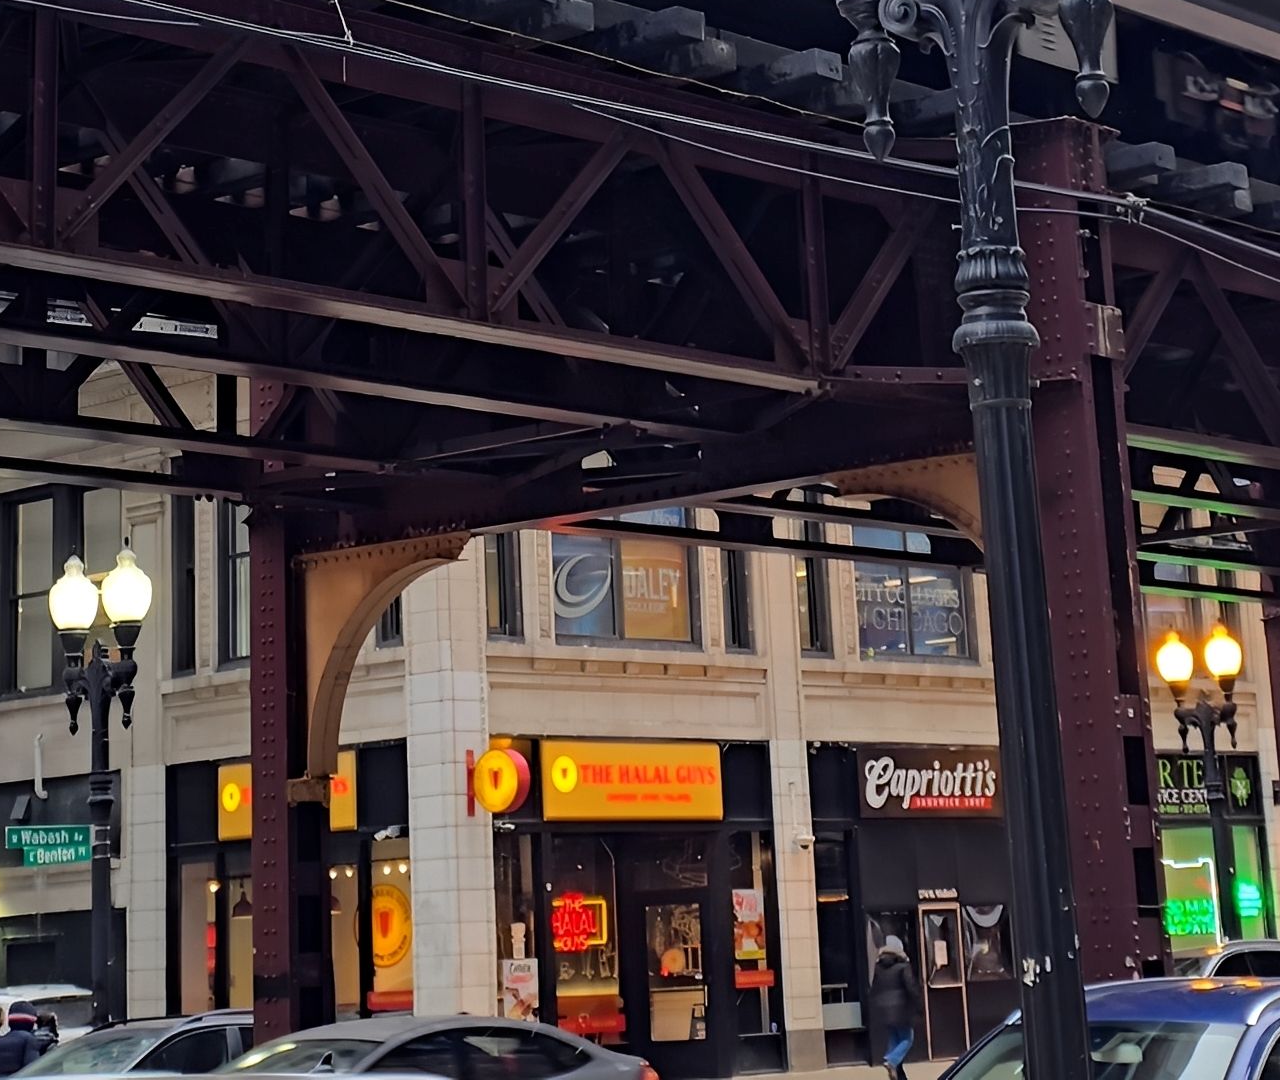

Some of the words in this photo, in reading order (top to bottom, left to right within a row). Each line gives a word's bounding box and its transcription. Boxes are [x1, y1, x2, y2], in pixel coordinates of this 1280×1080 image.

[623, 566, 680, 603] DALEY
[872, 607, 963, 636] CHICAGO
[581, 764, 613, 784] THE
[619, 765, 673, 785] HALAL
[676, 765, 717, 785] GUYS
[864, 756, 997, 810] Capriotti's
[20, 829, 70, 845] Wabash
[37, 847, 75, 863] Benton
[563, 897, 585, 913] THE
[552, 909, 597, 934] HALAL
